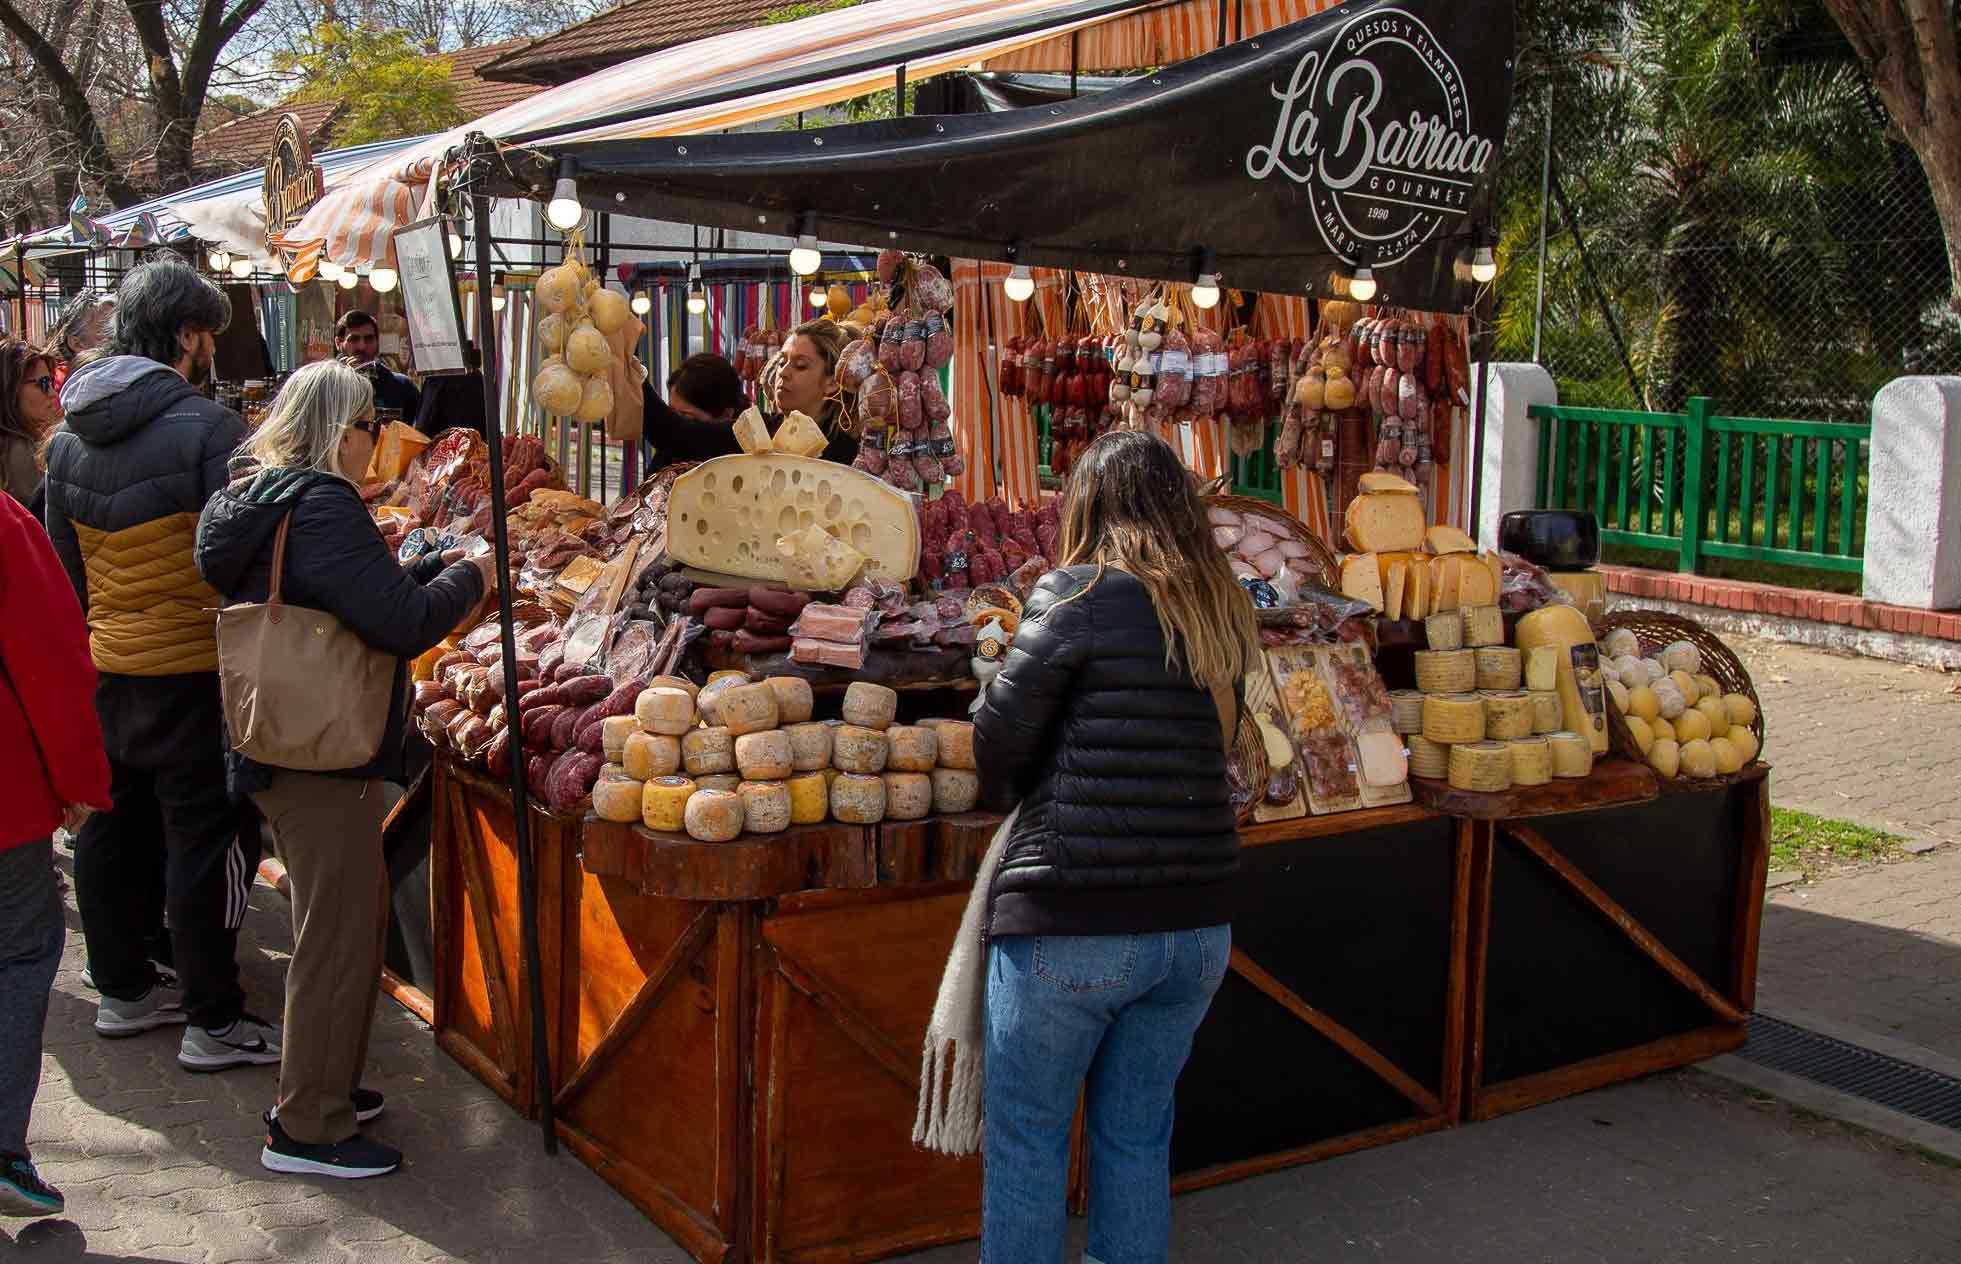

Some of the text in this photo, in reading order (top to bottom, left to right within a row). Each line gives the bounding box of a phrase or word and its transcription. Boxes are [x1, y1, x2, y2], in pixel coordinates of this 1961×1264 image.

[1346, 19, 1463, 119] QUESOS Y FIAMBRES
[1246, 51, 1494, 189] La Barraca
[1369, 175, 1467, 204] GOURMET
[1323, 211, 1345, 244] MAR
[1367, 207, 1390, 221] 1990
